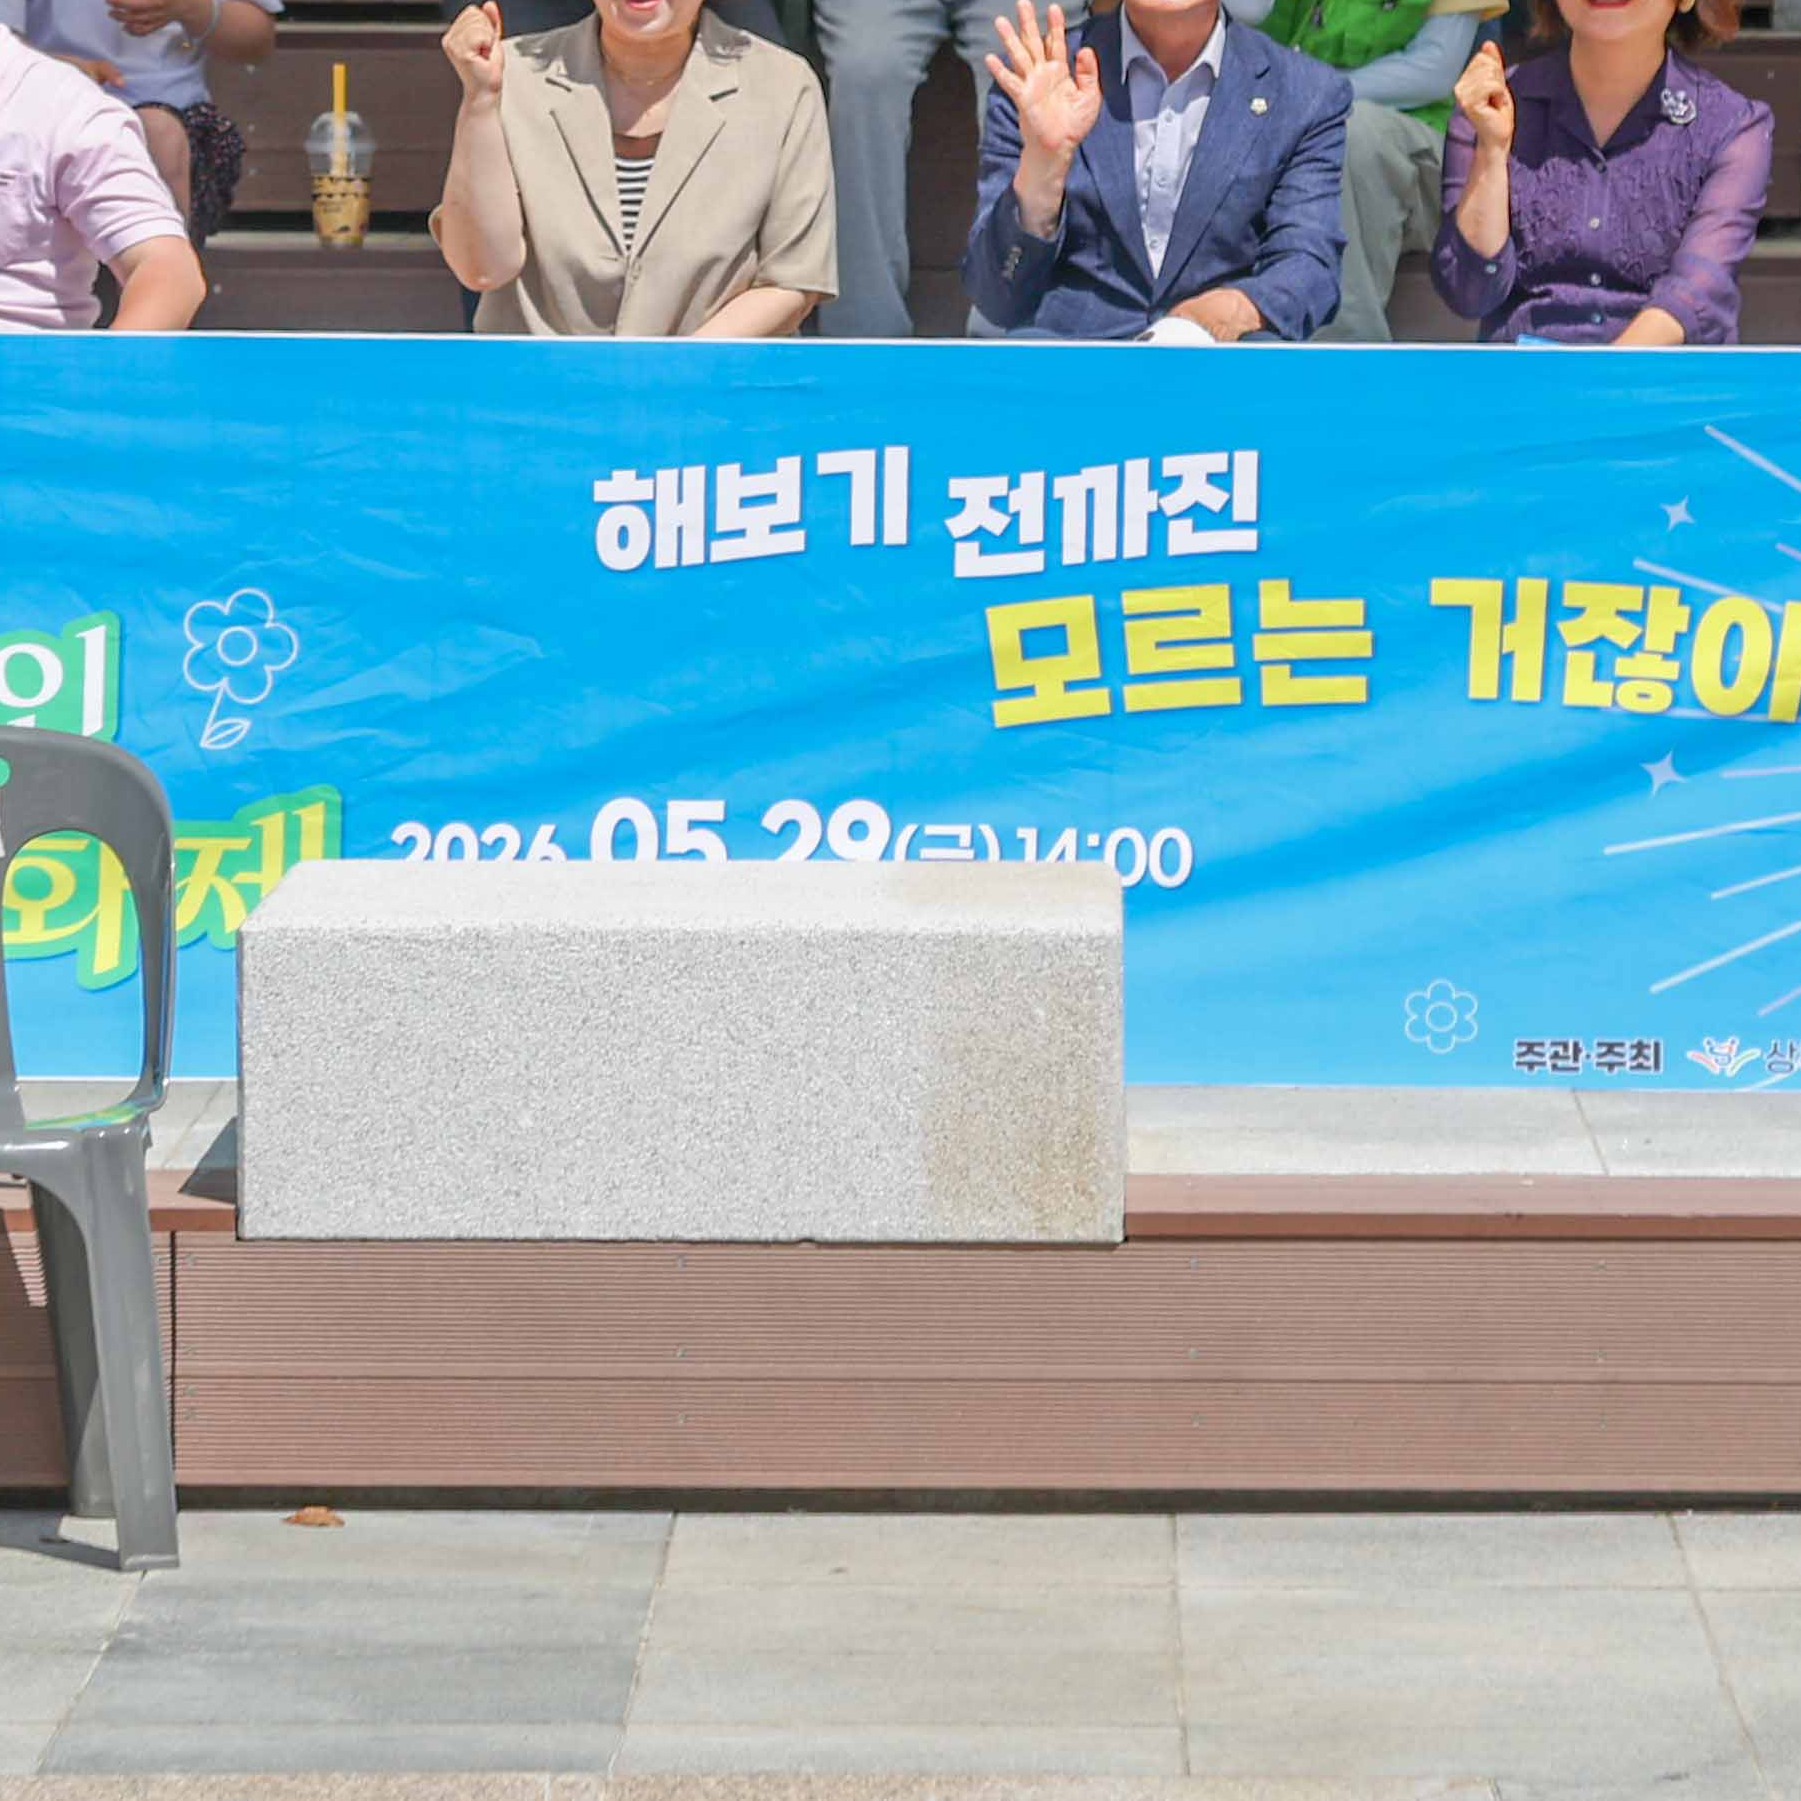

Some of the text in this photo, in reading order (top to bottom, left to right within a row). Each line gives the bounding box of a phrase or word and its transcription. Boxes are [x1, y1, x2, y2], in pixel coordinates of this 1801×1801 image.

[594, 445, 1261, 579] 해보기 전까진
[984, 578, 1373, 729] 모르는
